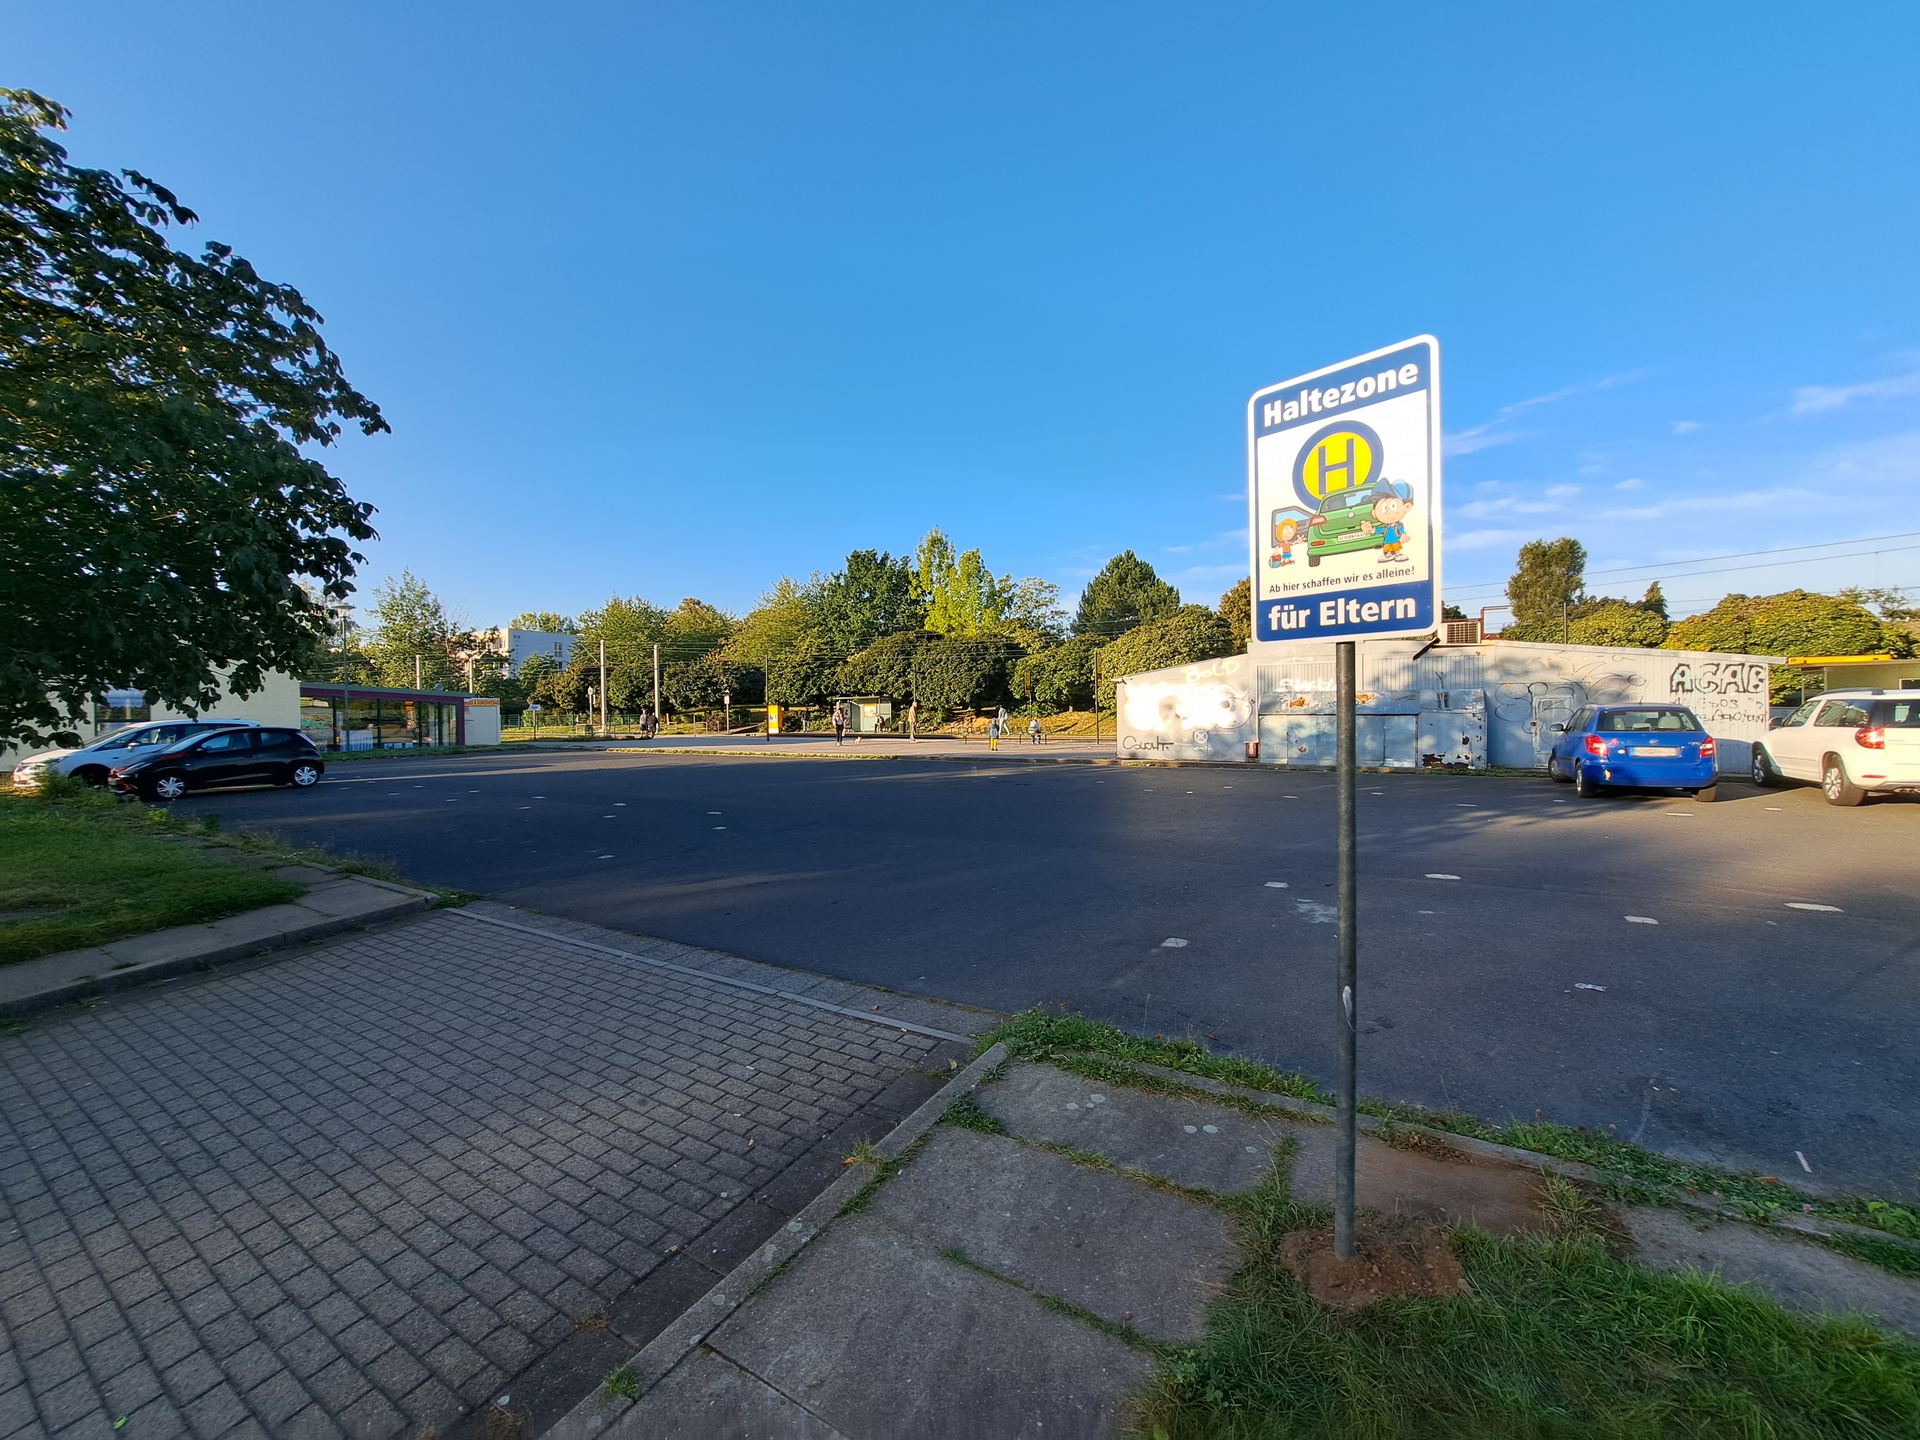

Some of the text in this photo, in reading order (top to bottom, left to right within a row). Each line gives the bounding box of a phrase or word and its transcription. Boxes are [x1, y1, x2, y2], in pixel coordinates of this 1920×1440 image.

[1263, 363, 1419, 428] Haltezone
[1317, 437, 1355, 495] H
[1269, 565, 1416, 594] Ab hier schaffen wir es alleine!
[1268, 597, 1416, 631] für Eltern
